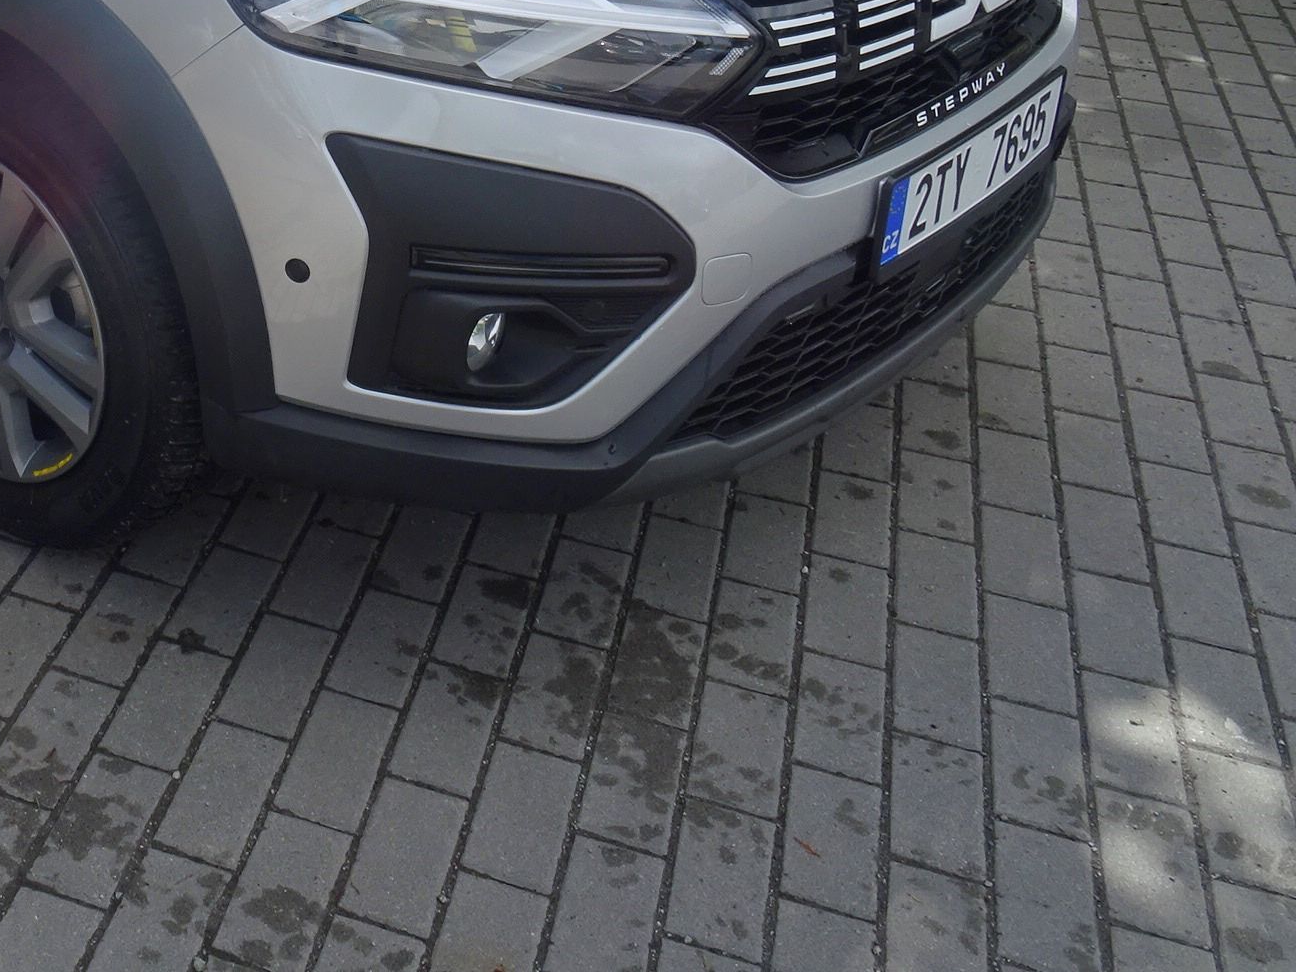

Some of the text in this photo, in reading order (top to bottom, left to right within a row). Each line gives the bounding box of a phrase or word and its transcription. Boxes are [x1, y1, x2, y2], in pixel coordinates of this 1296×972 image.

[915, 62, 1006, 128] STEPWAY
[907, 89, 1052, 241] 2TY 7695
[881, 229, 900, 254] CZ
